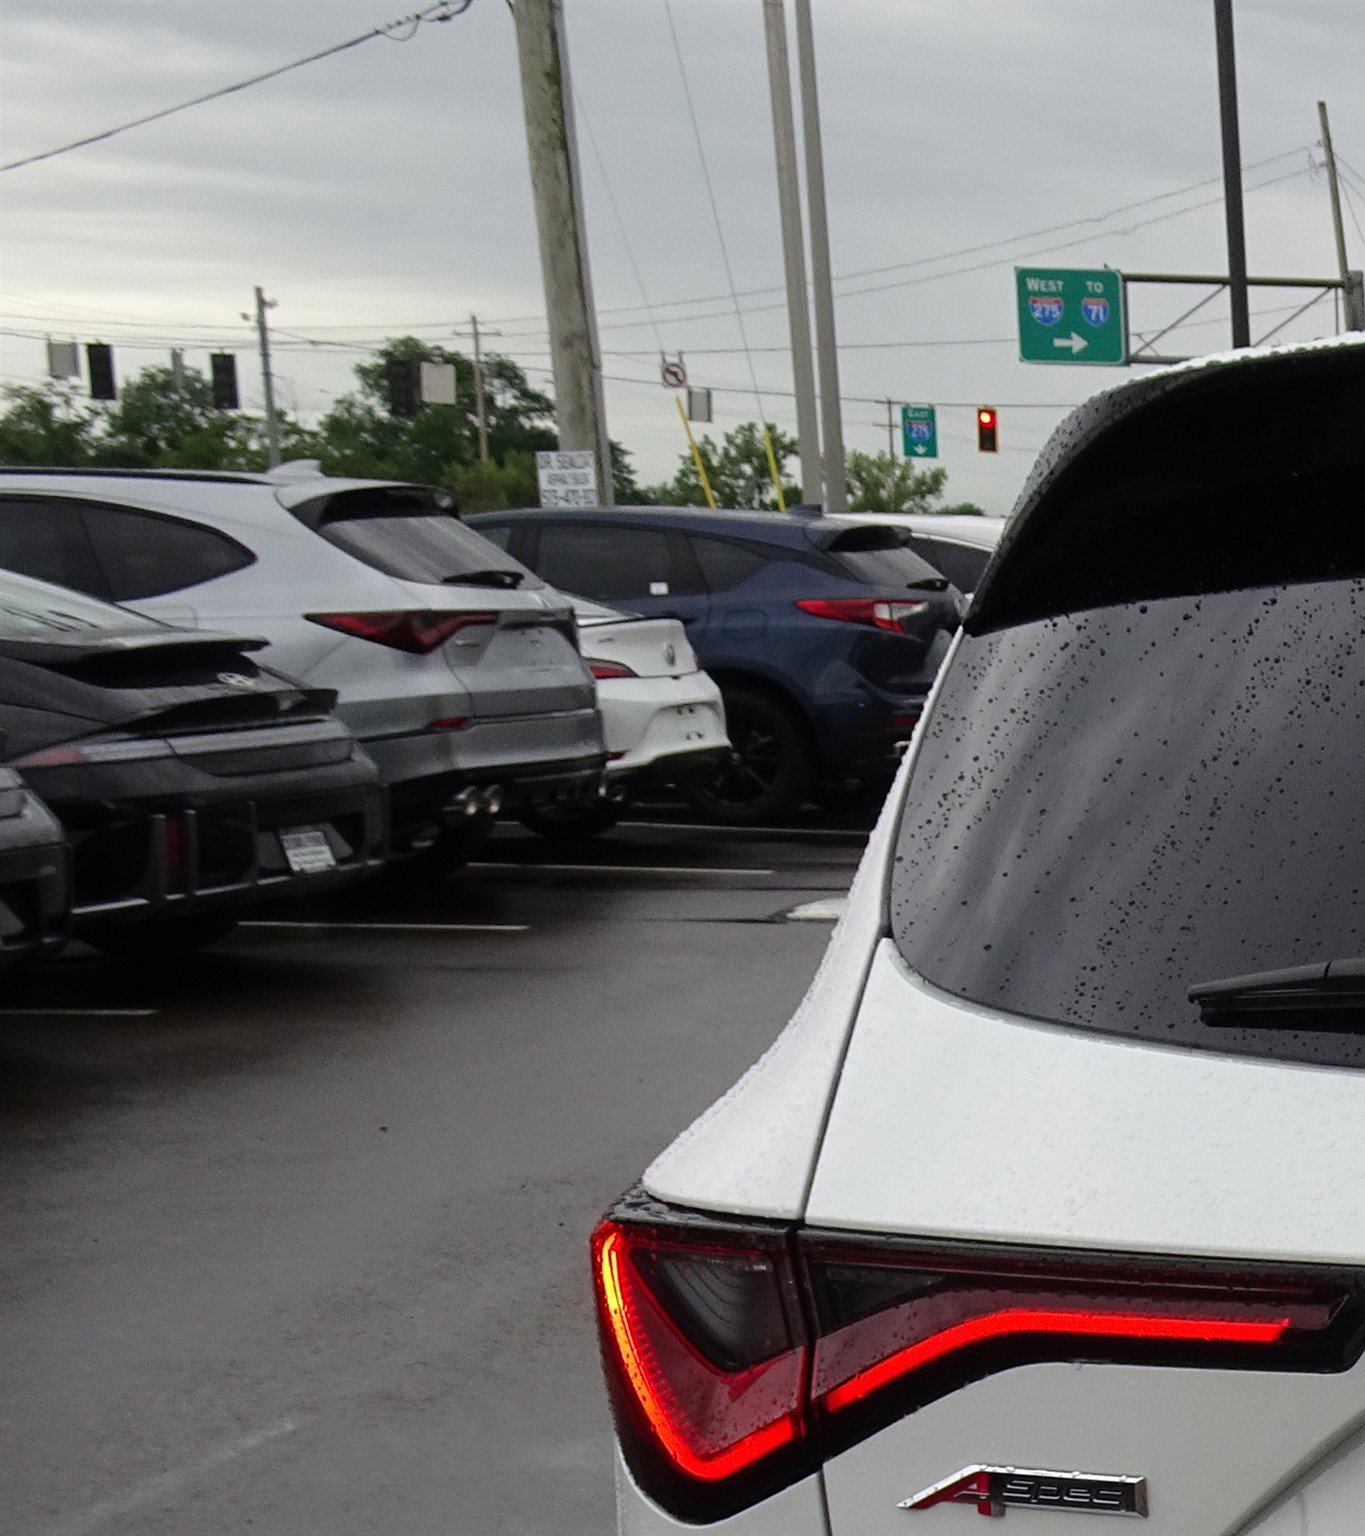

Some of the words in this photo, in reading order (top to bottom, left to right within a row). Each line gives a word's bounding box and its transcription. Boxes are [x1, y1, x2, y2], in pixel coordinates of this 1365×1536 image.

[1026, 277, 1064, 292] WEST
[1086, 281, 1104, 293] TO
[1087, 304, 1105, 320] 71
